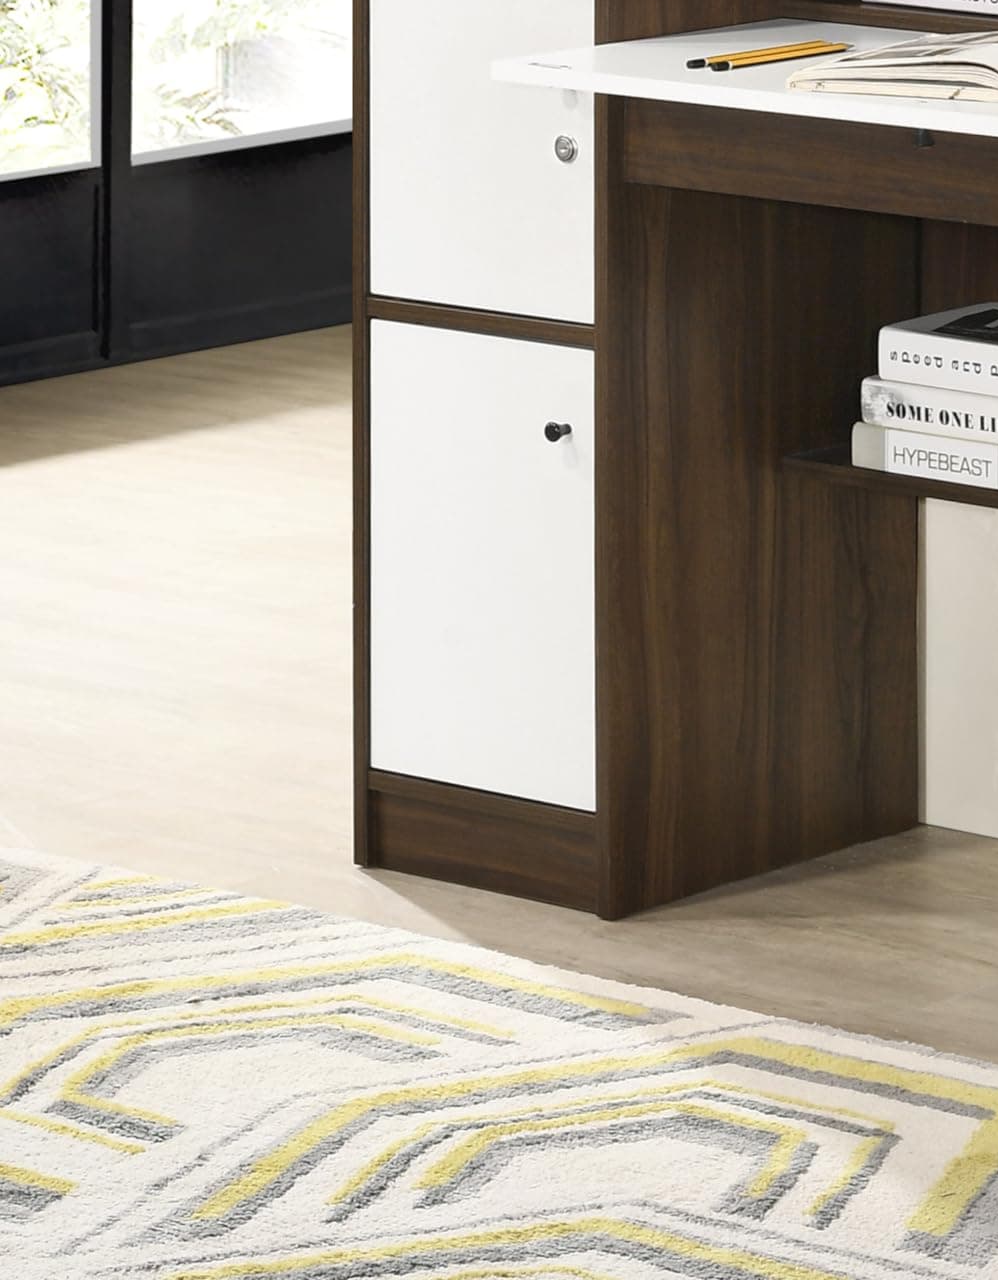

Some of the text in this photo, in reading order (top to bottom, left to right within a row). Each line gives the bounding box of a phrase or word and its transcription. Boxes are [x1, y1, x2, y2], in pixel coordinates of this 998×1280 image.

[886, 402, 934, 424] SOME
[939, 409, 975, 430] ONE
[893, 445, 993, 479] HYPEBEAST
